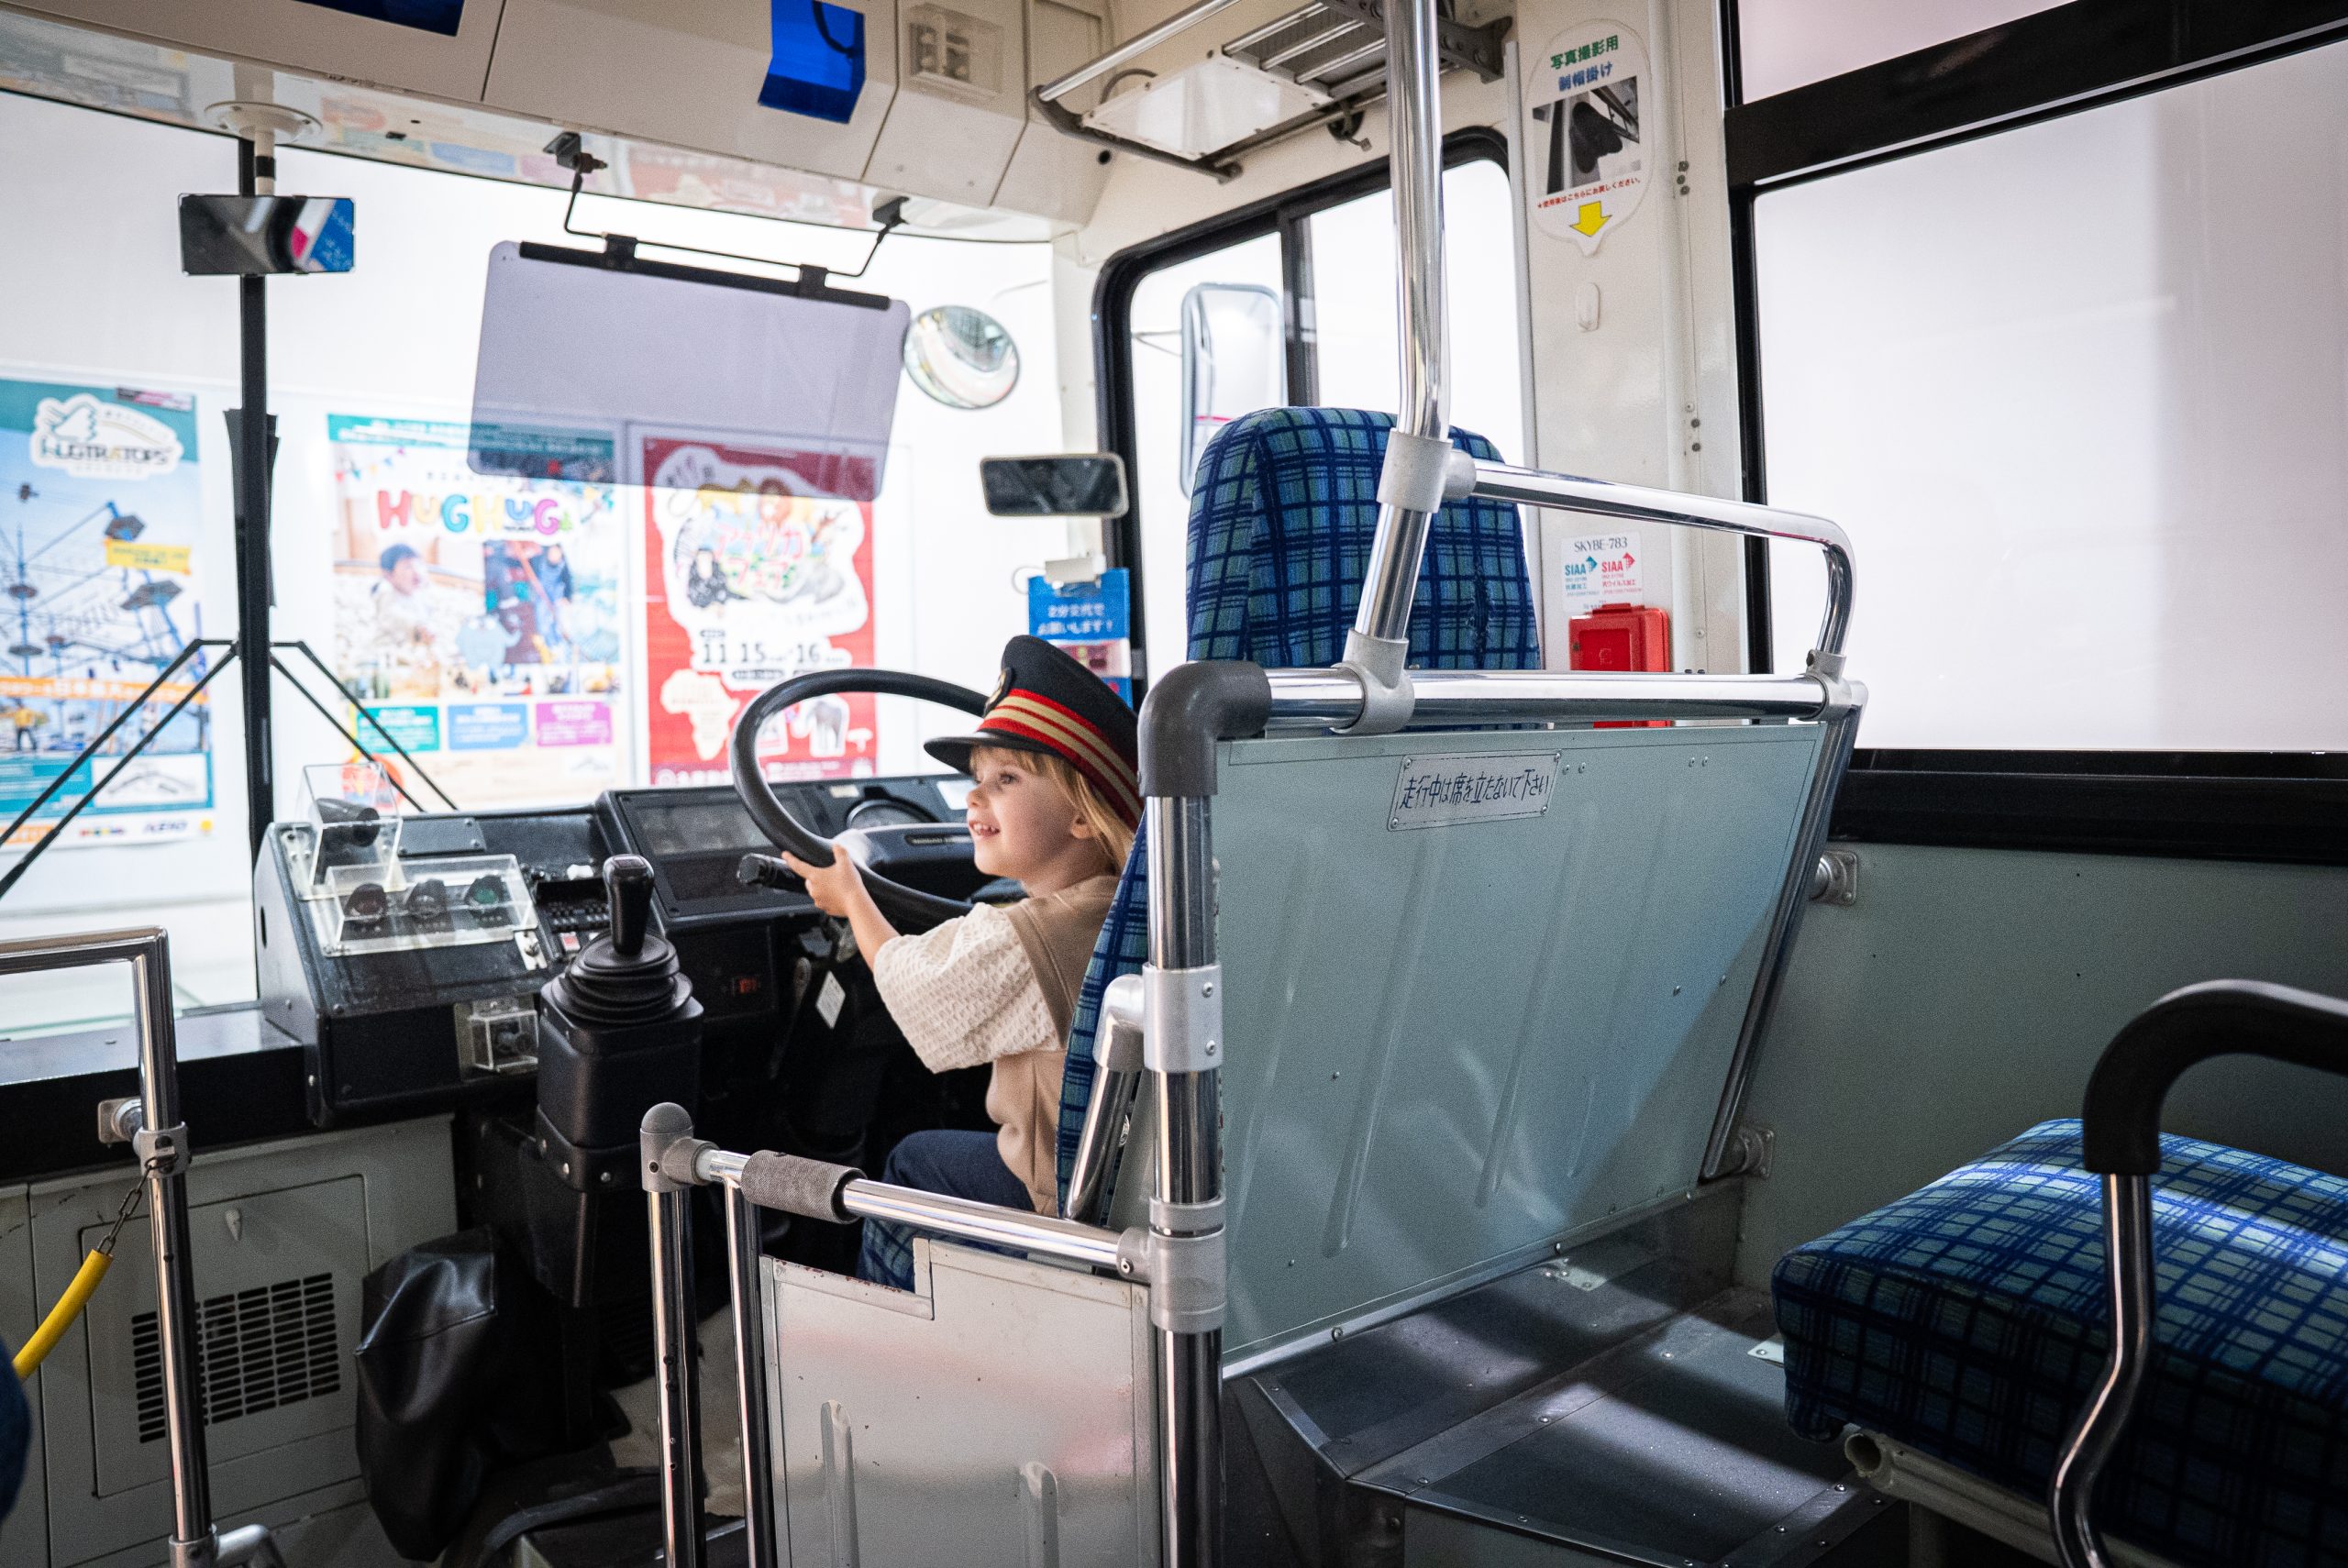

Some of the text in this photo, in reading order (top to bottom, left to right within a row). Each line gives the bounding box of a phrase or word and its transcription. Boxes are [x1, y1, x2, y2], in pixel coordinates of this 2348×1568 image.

[1550, 35, 1619, 70] 写真撮影用
[1558, 61, 1612, 92] 制帽掛け
[1565, 563, 1587, 577] SIAA
[1601, 560, 1623, 573] SIAA
[1399, 768, 1550, 810] 走行中は席を立たないで下さい
